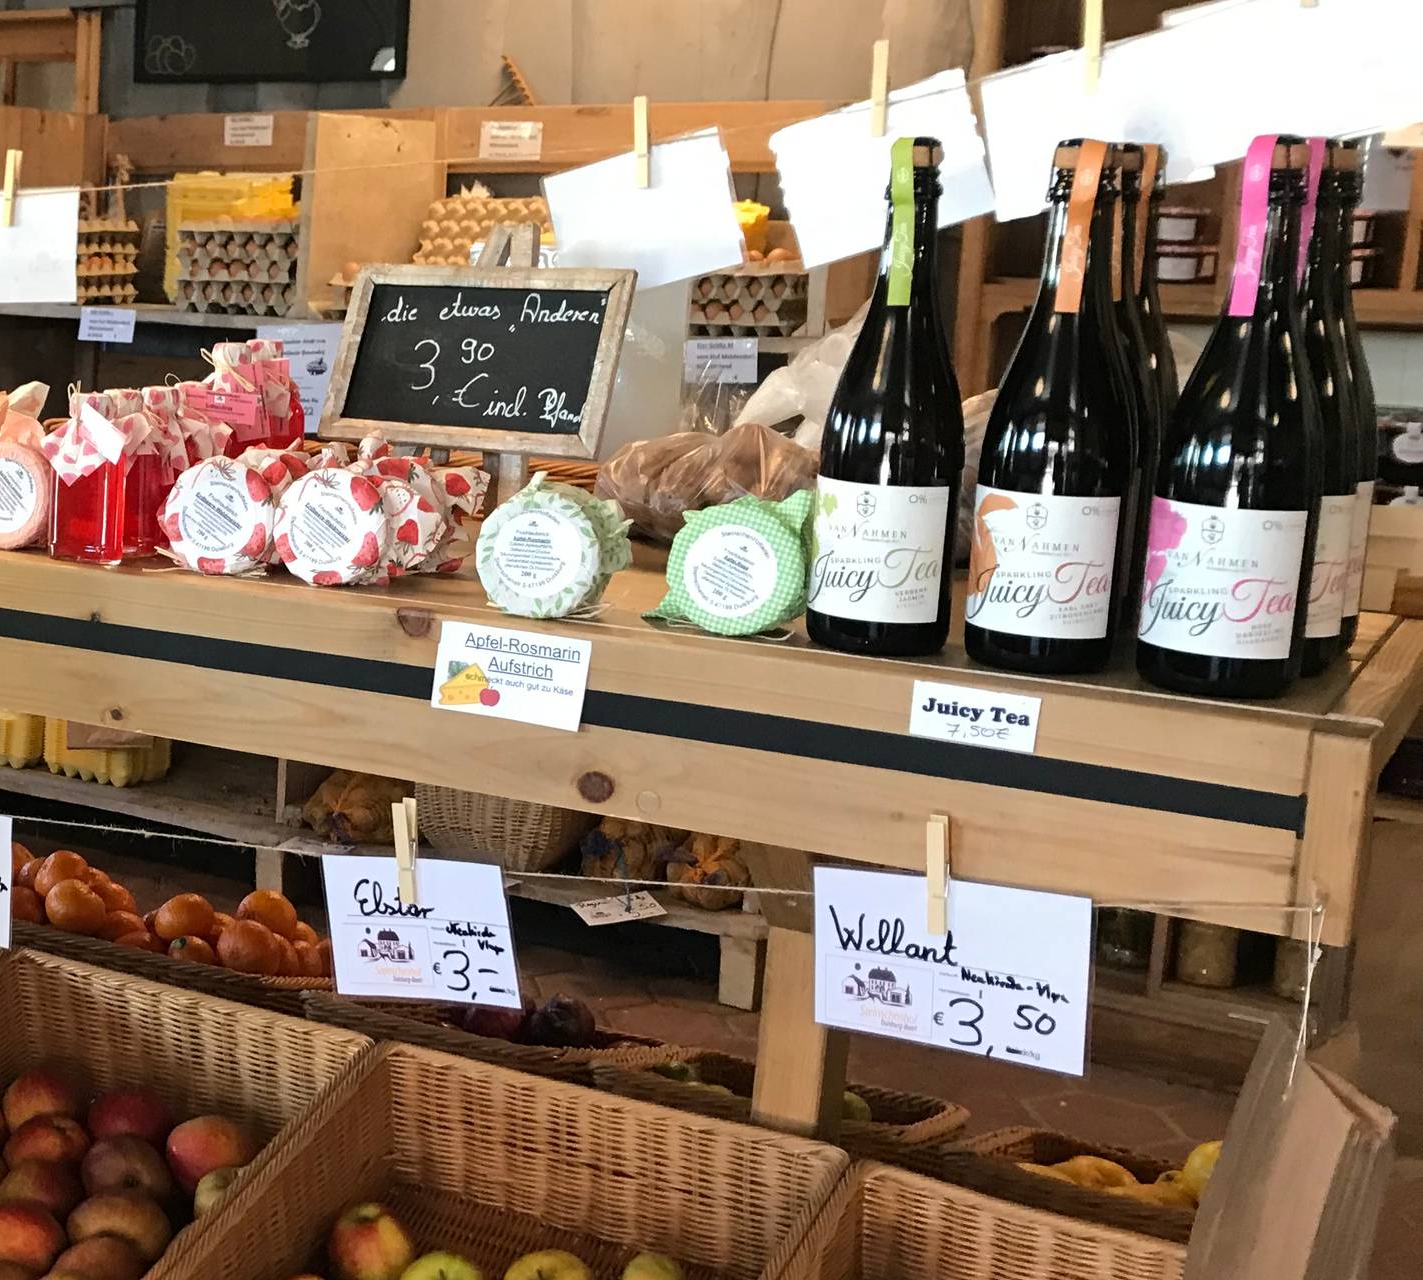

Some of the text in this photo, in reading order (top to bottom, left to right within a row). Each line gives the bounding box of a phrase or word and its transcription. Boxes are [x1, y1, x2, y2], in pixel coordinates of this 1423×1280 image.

[439, 292, 501, 320] etwas
[830, 555, 882, 564] SPARKLING
[808, 550, 877, 603] Juicy
[877, 546, 939, 589] Tea
[995, 570, 1052, 579] SPARKLING
[965, 561, 1110, 619] Juicy Tea
[1168, 586, 1228, 595] SPARKLING
[1139, 577, 1294, 637] Juicy Tea
[464, 632, 581, 662] Apfel-Rosmarin
[487, 656, 554, 679] Aufstrich
[505, 679, 525, 688] auch
[526, 682, 540, 691] gut
[553, 685, 574, 696] Käse
[922, 697, 1030, 726] Juicy Tea
[353, 878, 435, 919] Elstar
[829, 904, 958, 966] Wellant
[433, 962, 442, 975] €
[933, 1011, 945, 1026] €
